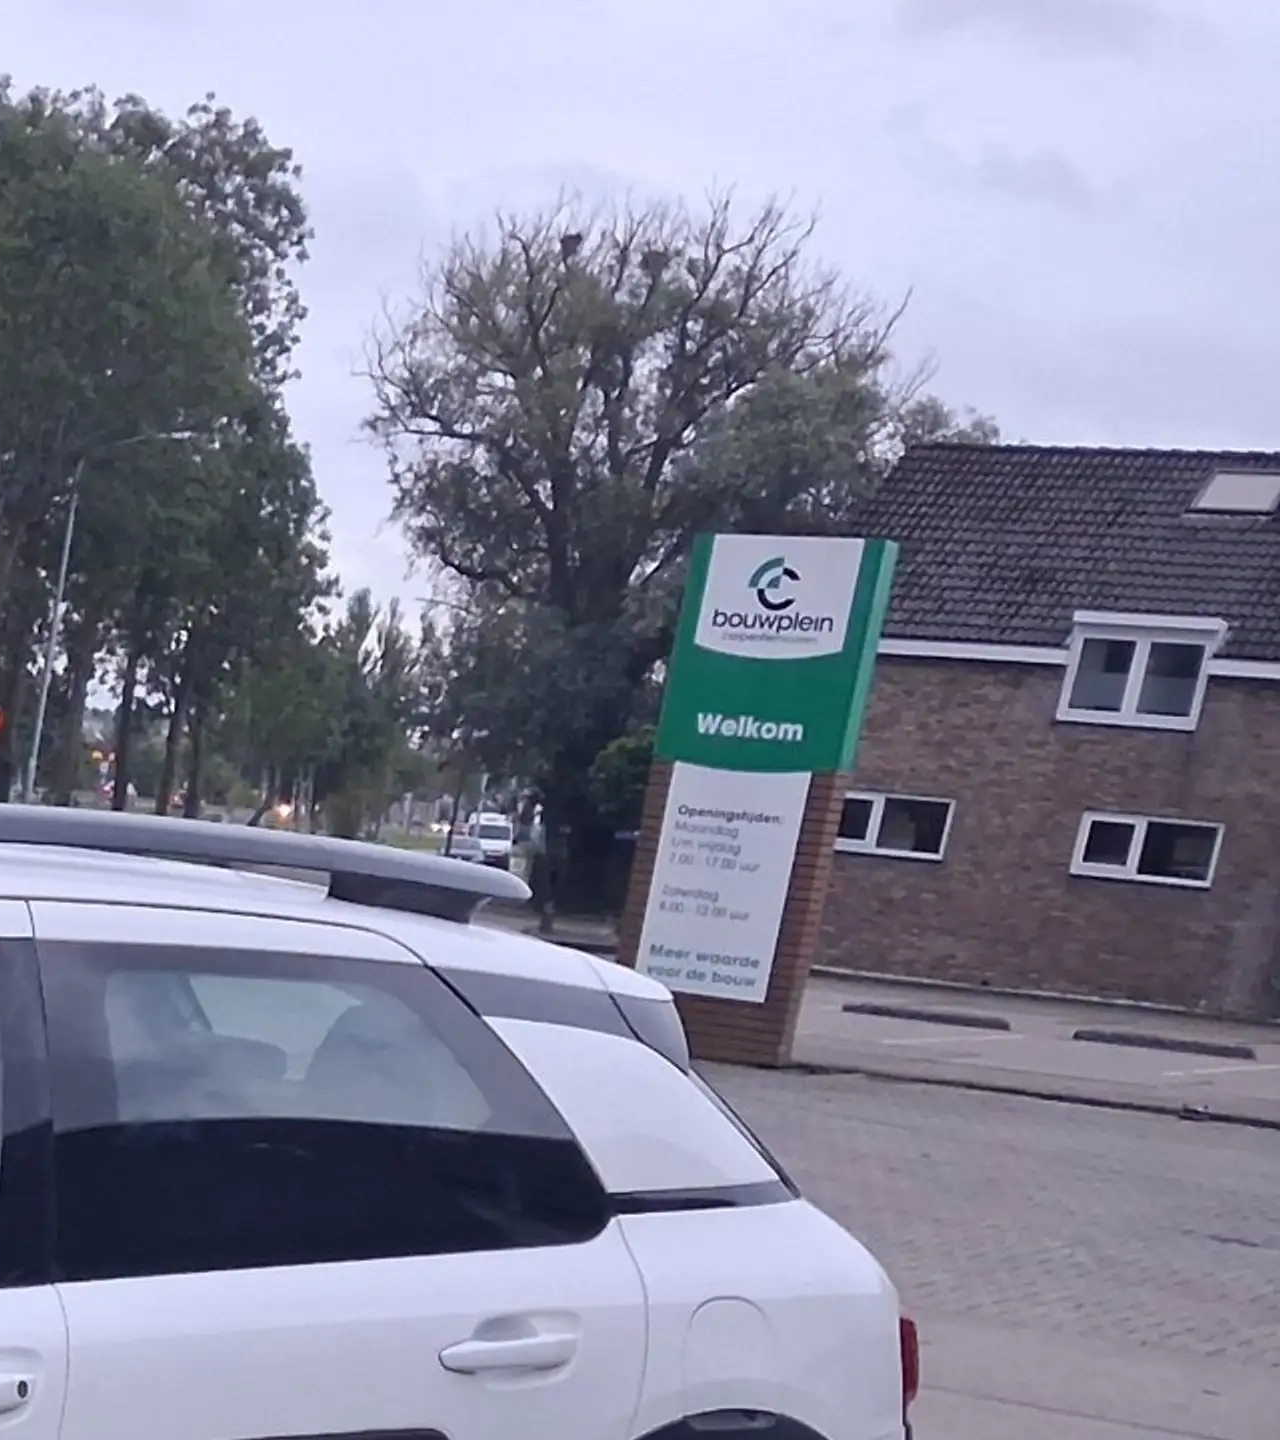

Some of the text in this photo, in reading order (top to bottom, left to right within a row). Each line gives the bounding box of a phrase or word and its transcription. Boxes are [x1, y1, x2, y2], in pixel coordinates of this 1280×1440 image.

[712, 608, 833, 633] bouwplein
[697, 712, 803, 741] Welkom
[650, 943, 760, 969] Meer waarde
[646, 964, 757, 987] voor de bouw
